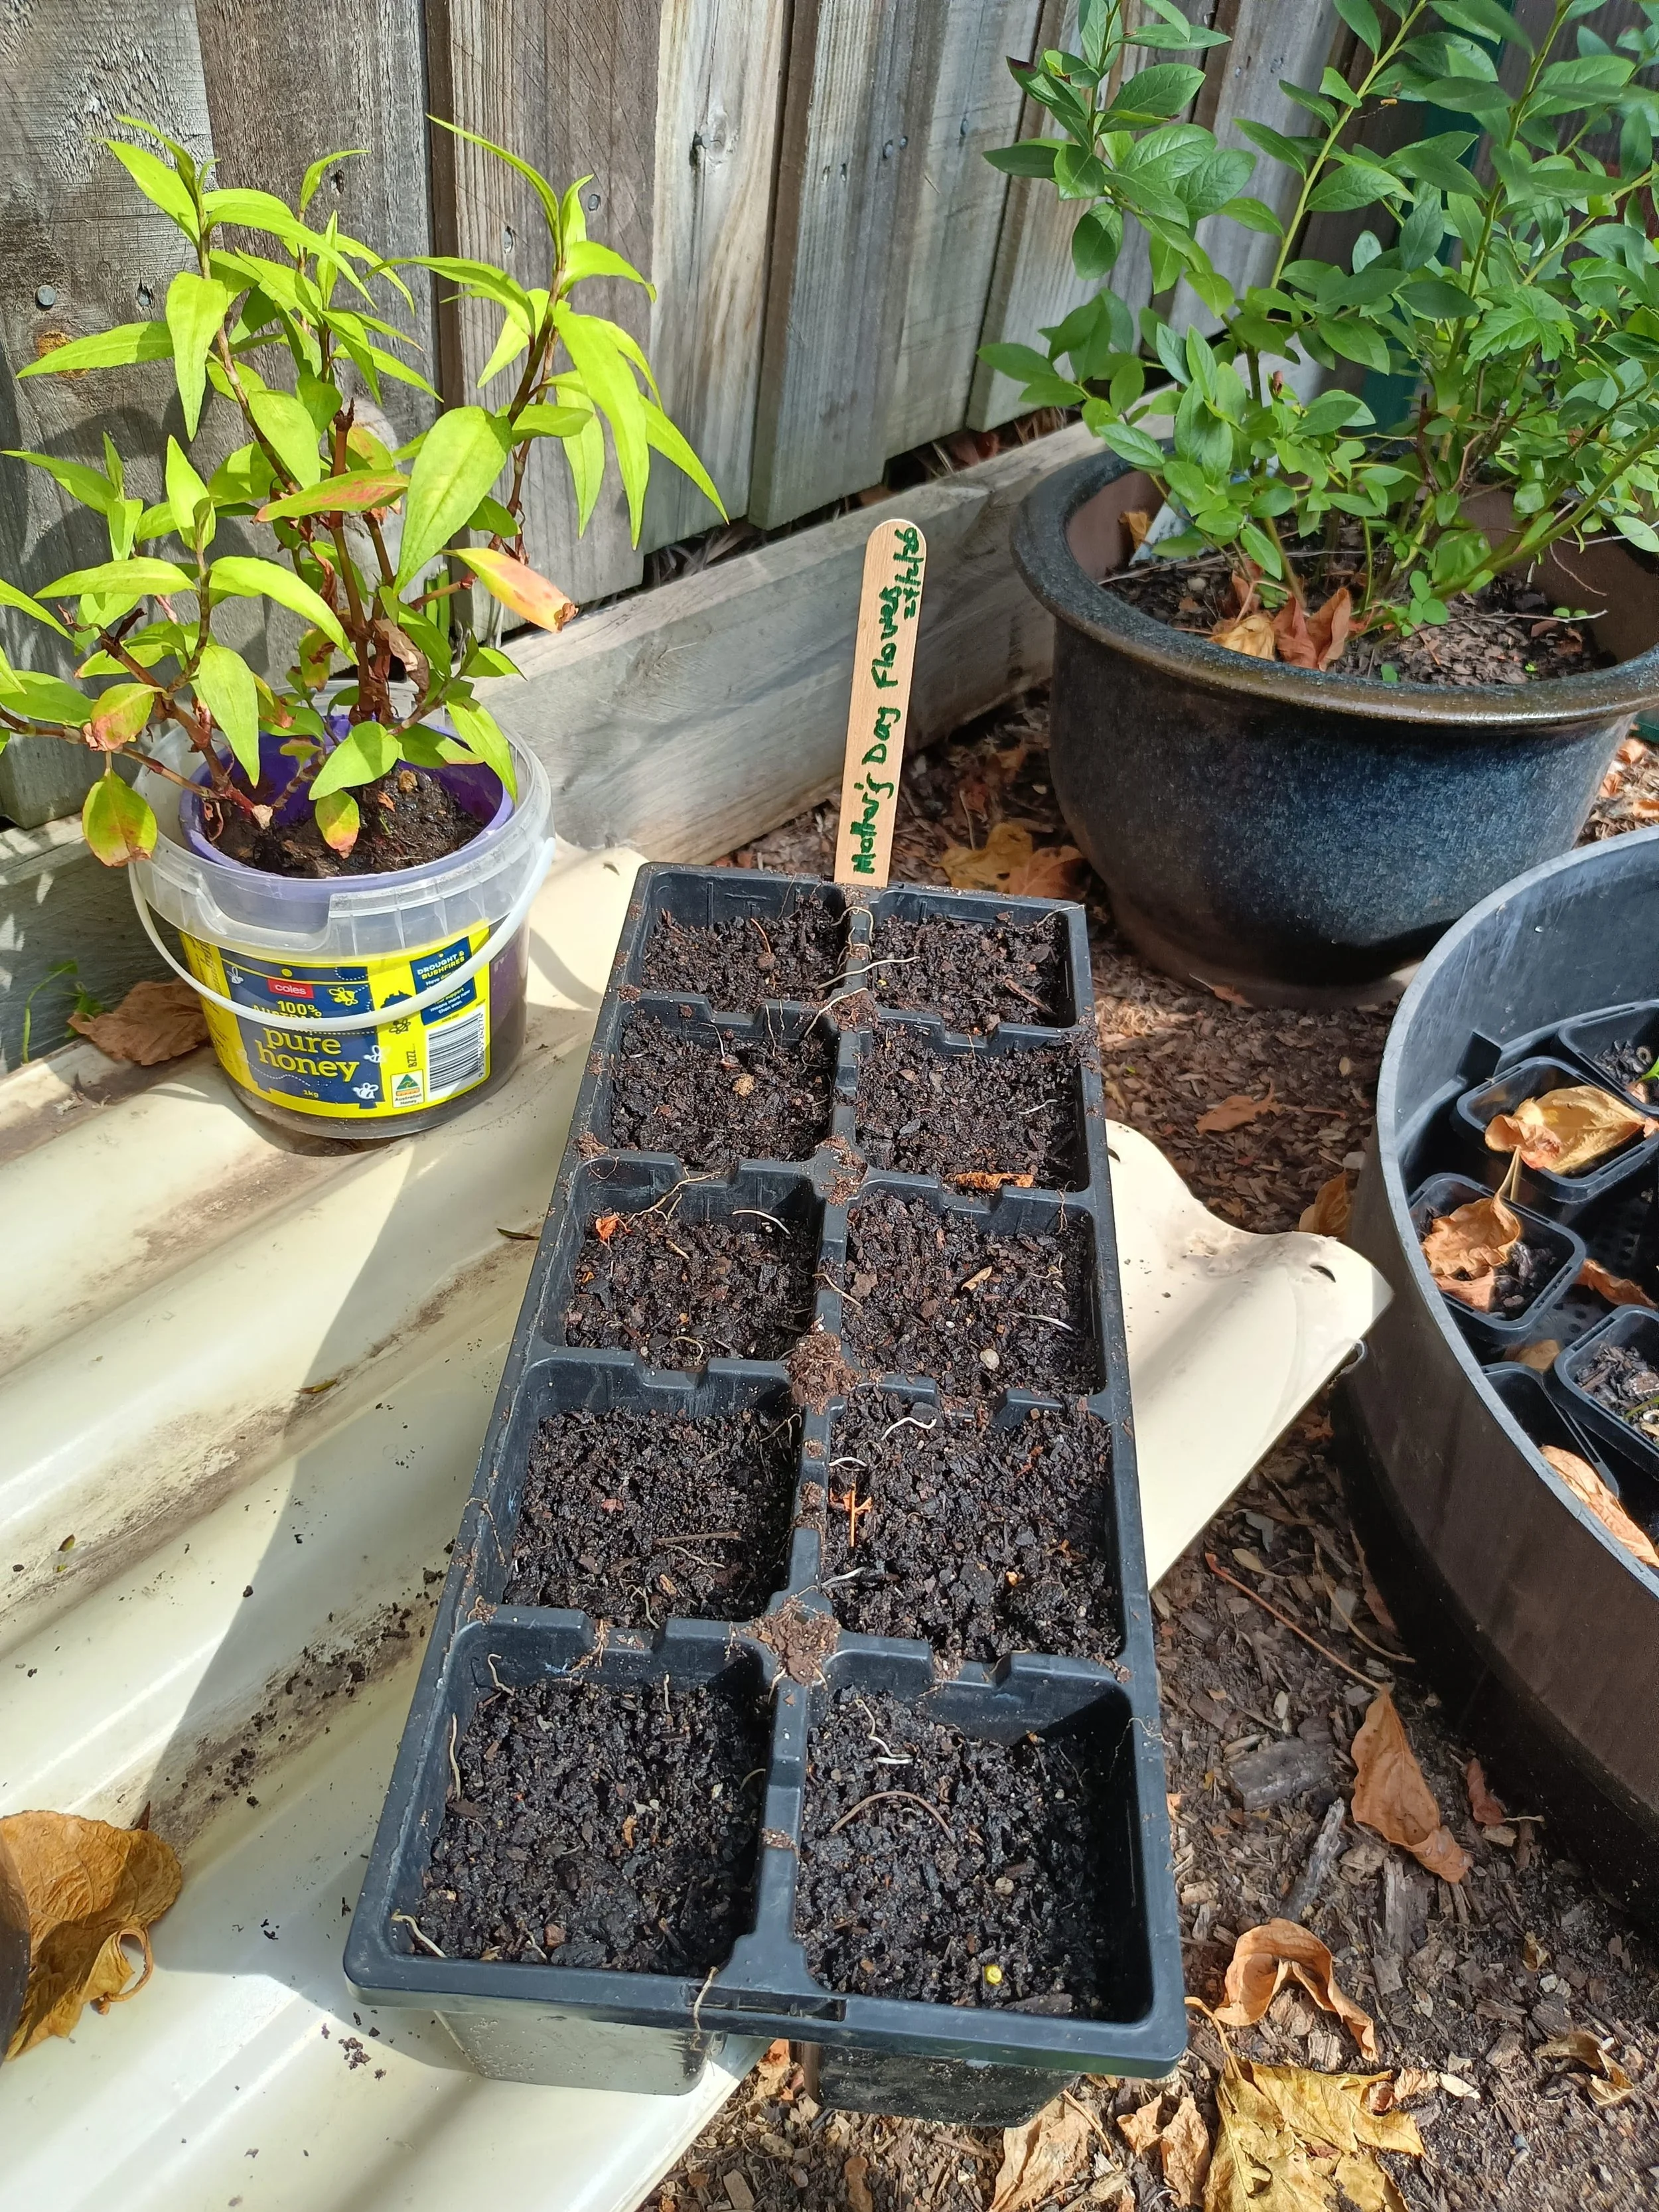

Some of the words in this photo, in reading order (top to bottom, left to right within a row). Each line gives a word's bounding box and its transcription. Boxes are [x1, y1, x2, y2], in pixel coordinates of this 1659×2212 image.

[861, 705, 901, 765] Day
[417, 954, 458, 976] DROUGHT
[421, 956, 465, 980] BUSHFIRES
[275, 984, 307, 995] coles
[277, 1000, 323, 1017] 100%
[263, 1027, 342, 1055] pure
[254, 1039, 360, 1082] honey
[303, 1090, 319, 1098] 1kg
